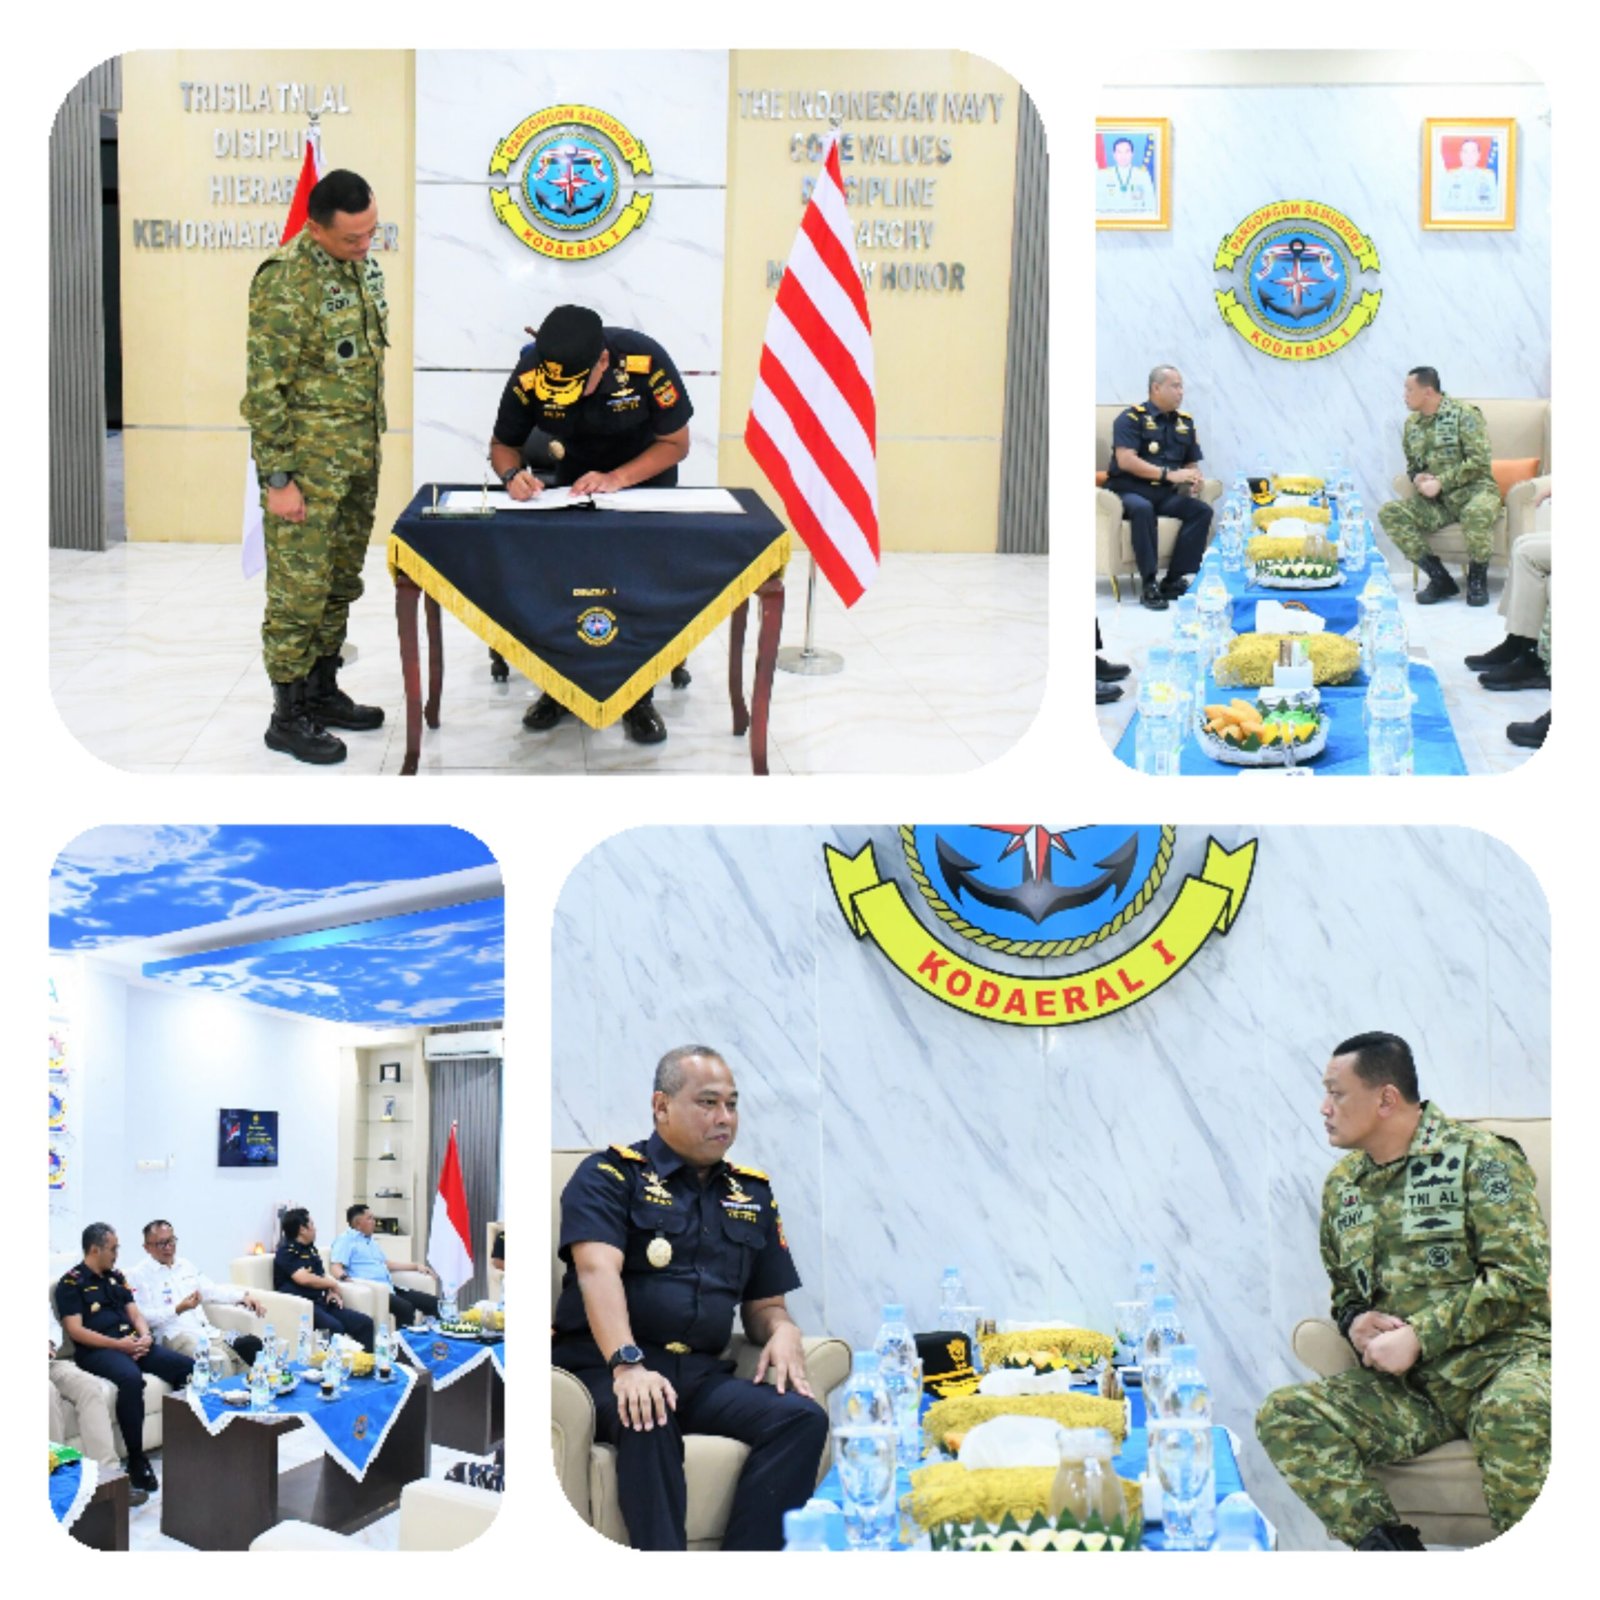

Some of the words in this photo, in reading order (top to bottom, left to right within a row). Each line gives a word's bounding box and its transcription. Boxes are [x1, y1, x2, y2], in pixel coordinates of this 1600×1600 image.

[180, 82, 272, 113] TRISILA
[322, 84, 351, 114] AL
[738, 89, 784, 120] THE
[789, 90, 938, 122] INDONESIAN
[943, 91, 1004, 124] NAVY
[789, 132, 855, 163] COE
[860, 133, 953, 165] VALUES
[209, 174, 298, 205] HIERAR
[802, 175, 937, 207] DCIPLINE
[133, 219, 281, 251] KEHORMATA
[523, 228, 608, 257] KODAERAL
[611, 230, 622, 241] I
[881, 261, 967, 291] HONOR
[1250, 329, 1338, 358] KODAERAL
[1340, 327, 1351, 338] I
[917, 950, 1145, 1018] KODAERAL
[1151, 939, 1177, 966] I
[1408, 1192, 1430, 1206] TNI
[1440, 1190, 1458, 1203] AL
